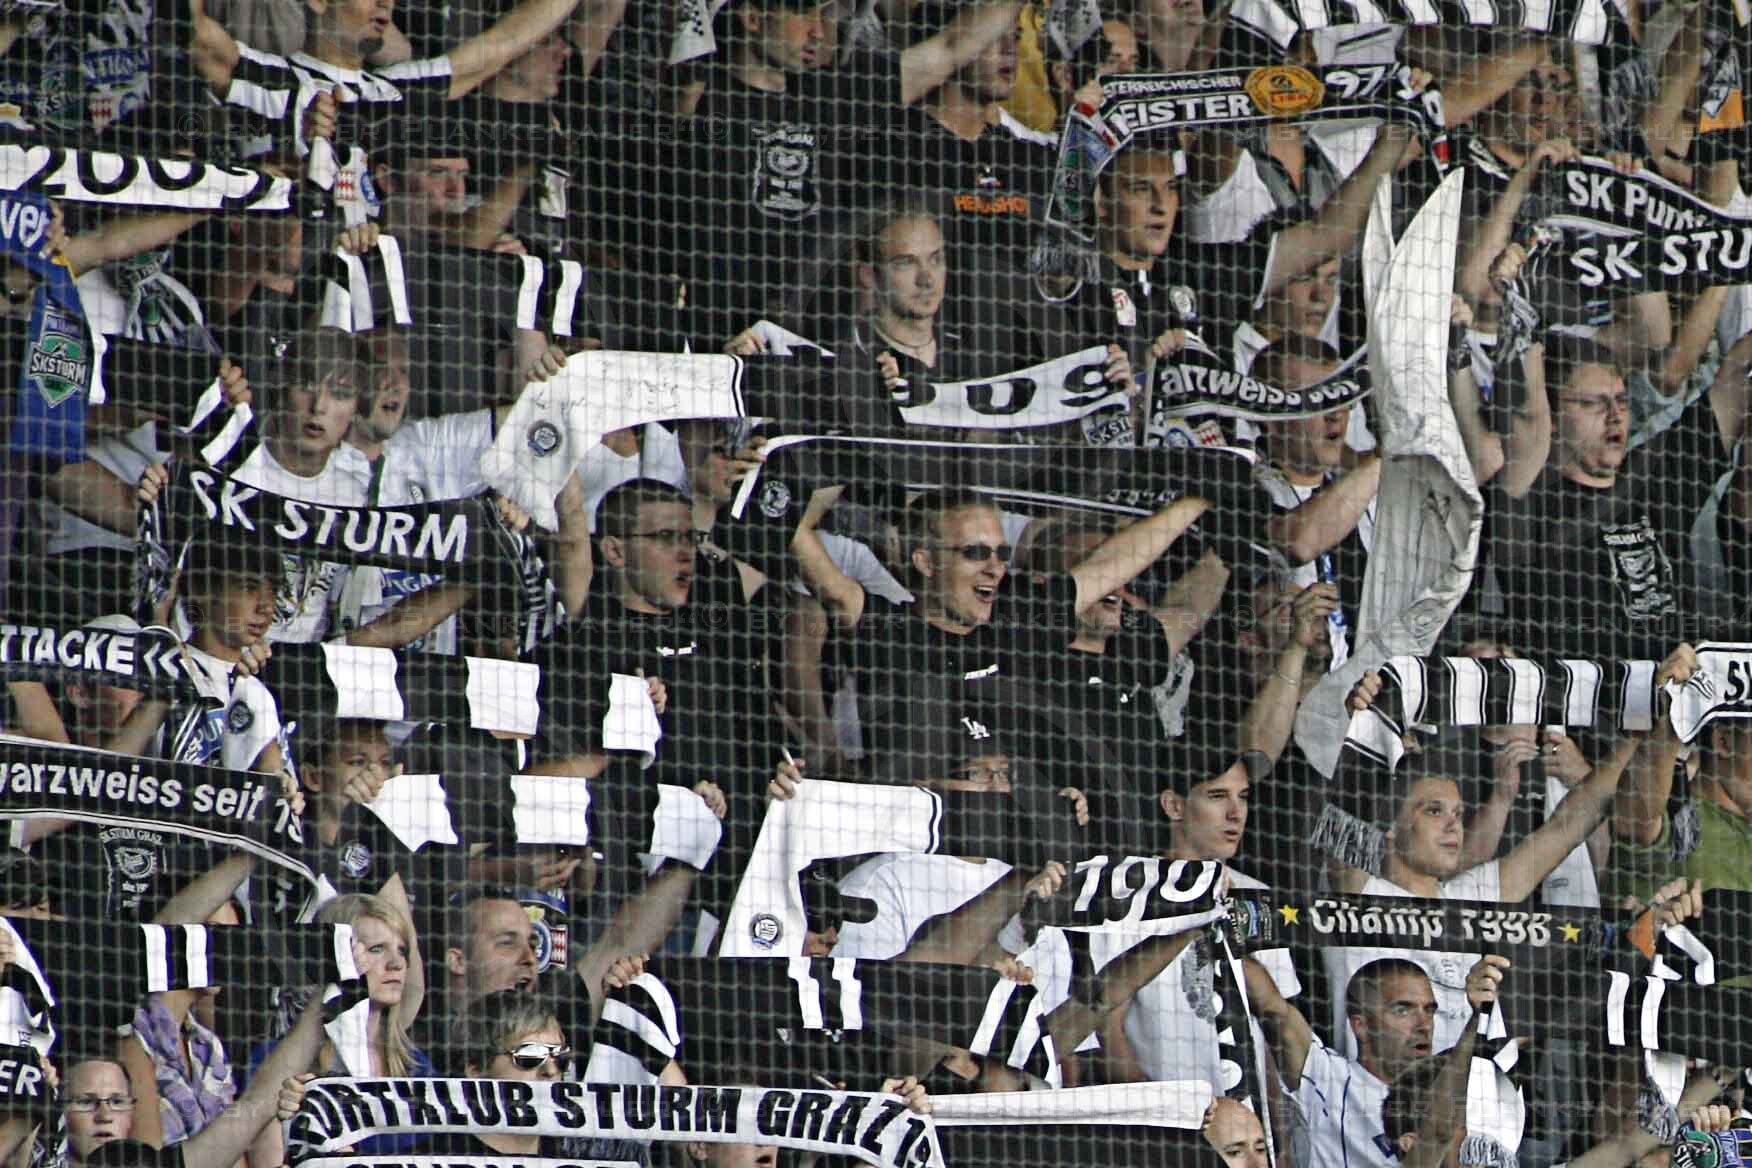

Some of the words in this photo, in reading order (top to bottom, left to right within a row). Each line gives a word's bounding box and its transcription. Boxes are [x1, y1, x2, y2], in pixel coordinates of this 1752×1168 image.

[1566, 170, 1614, 213] SK
[1569, 240, 1641, 287] SK
[190, 470, 255, 533] SK
[275, 502, 468, 563] STURM
[192, 781, 267, 821] seit
[1309, 899, 1447, 946] Champ
[554, 1080, 741, 1135] STURM
[756, 1086, 911, 1153] GRAZ
